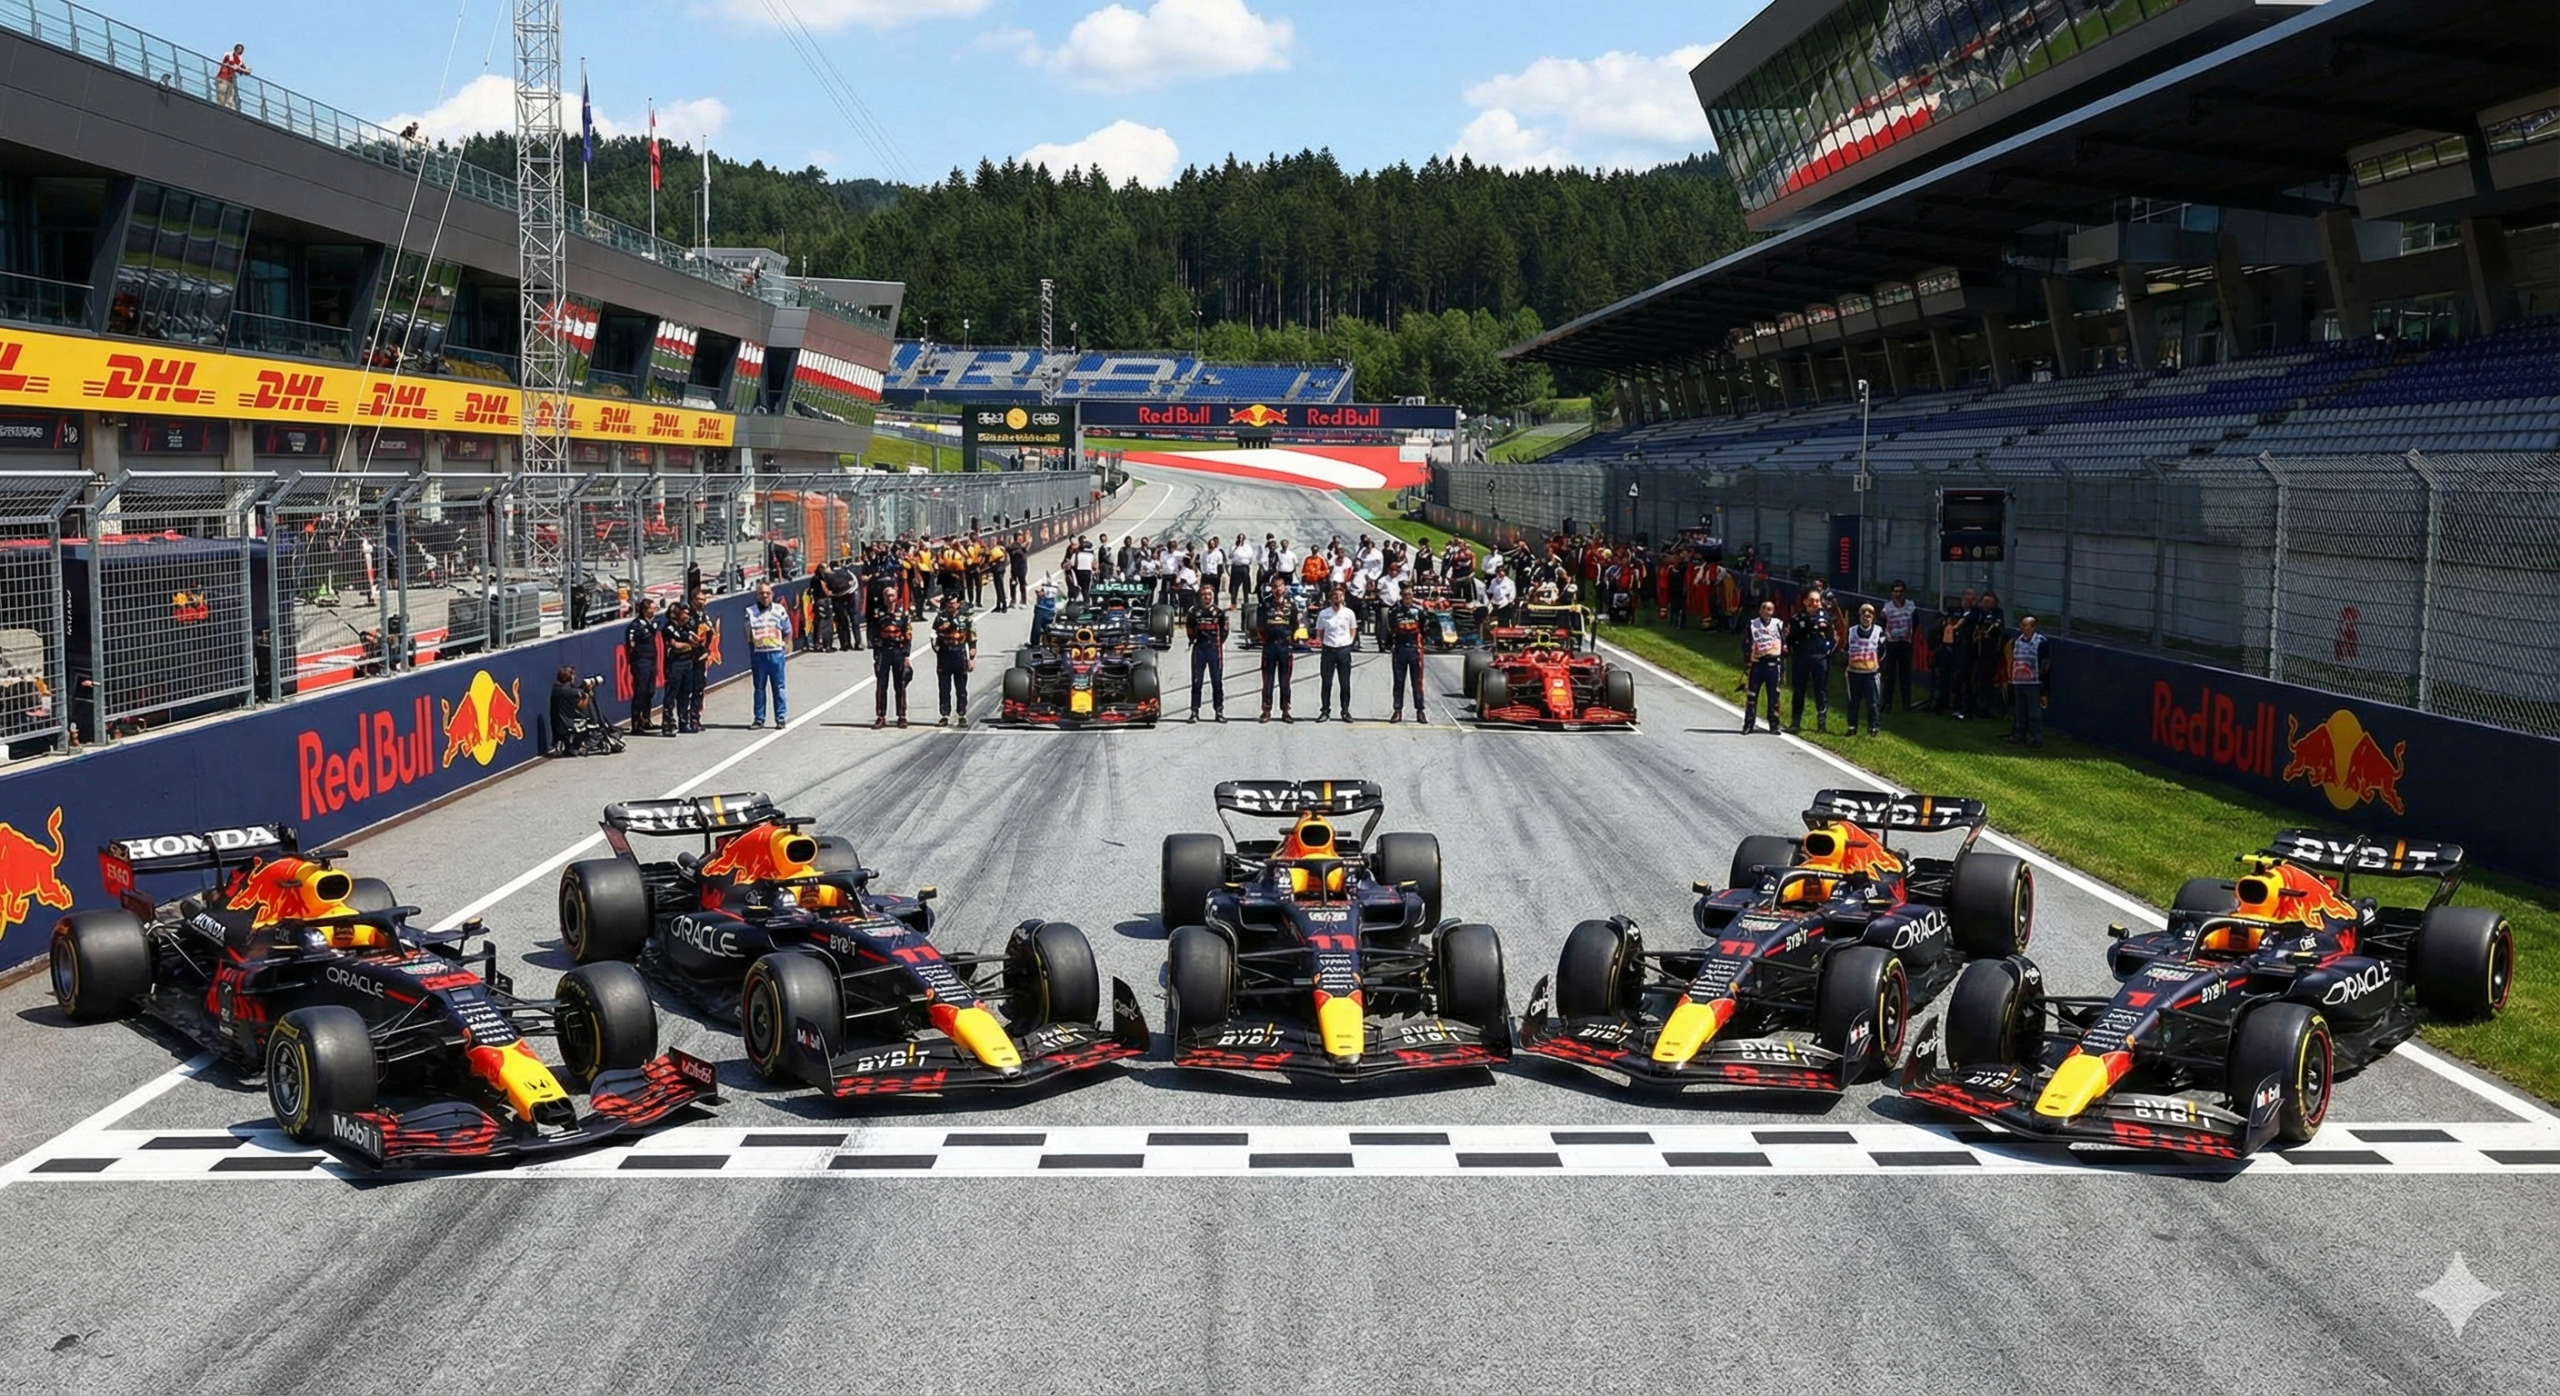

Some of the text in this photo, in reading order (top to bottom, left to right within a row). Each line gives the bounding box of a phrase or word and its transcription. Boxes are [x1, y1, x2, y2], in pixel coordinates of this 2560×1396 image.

[102, 354, 201, 404] DHL
[254, 370, 328, 413] DHL
[370, 383, 428, 419] DHL
[463, 392, 511, 425] DHL
[1139, 406, 1210, 424] Red Bull
[1307, 408, 1380, 426] Red Bull
[600, 406, 632, 433] DHL
[653, 412, 681, 438] DHL
[2152, 679, 2276, 779] Red Bull
[298, 694, 435, 821] Red Bull
[120, 826, 282, 860] HONDA
[2288, 837, 2438, 871] BYBIT
[670, 914, 746, 958] ORACLE
[1308, 934, 1356, 950] 11
[1720, 940, 1757, 957] 11
[891, 945, 941, 964] 11
[326, 966, 385, 999] ORACLE
[2322, 961, 2392, 1006] ORACLE
